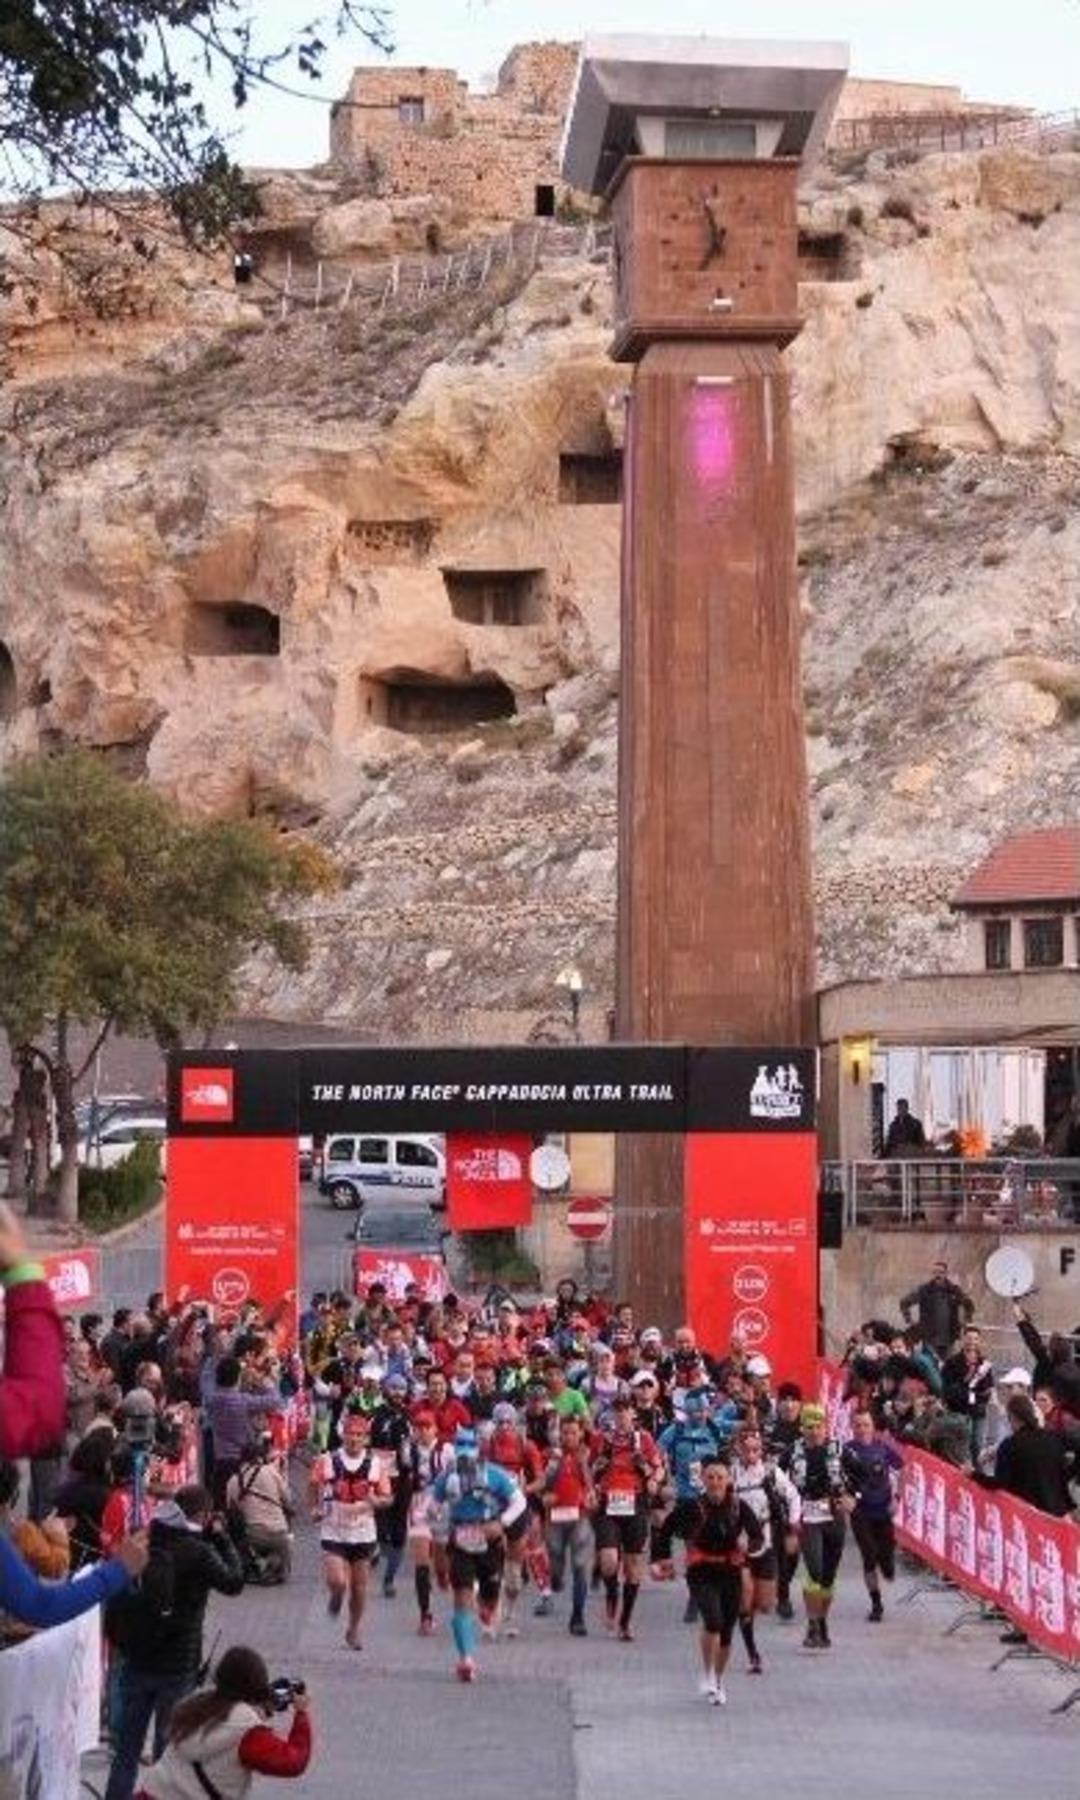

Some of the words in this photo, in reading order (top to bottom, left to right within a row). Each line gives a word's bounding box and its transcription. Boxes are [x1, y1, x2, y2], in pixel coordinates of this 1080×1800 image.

[313, 1084, 344, 1101] THE
[349, 1084, 405, 1101] NORTH
[465, 1084, 566, 1101] CAPPADOCIA
[572, 1084, 622, 1101] ULTRA
[629, 1084, 674, 1101] TRAIL
